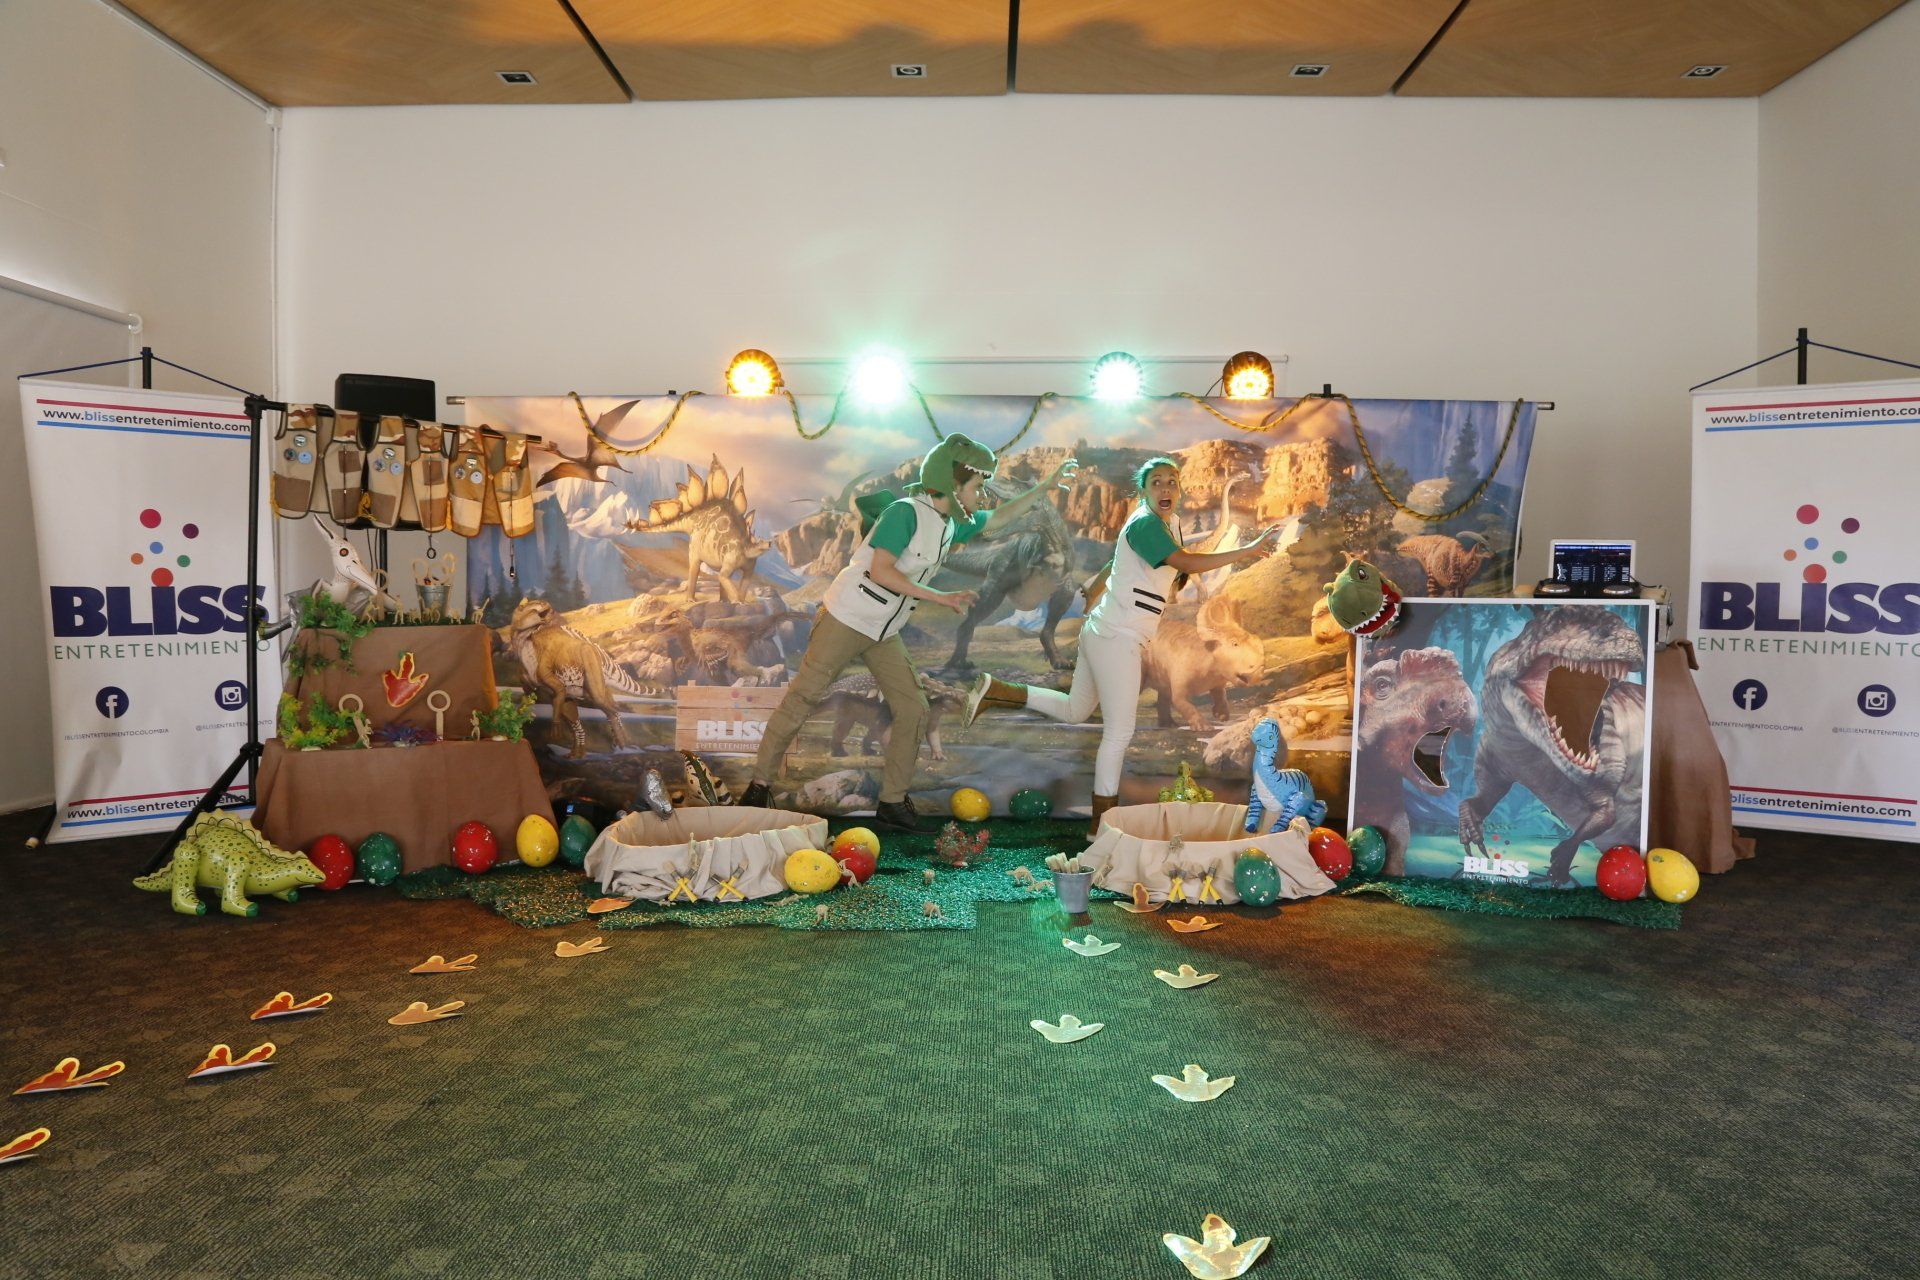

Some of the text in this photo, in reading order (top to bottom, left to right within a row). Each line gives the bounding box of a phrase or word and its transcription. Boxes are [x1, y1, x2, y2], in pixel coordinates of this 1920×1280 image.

[43, 408, 250, 432] www.blissentretenimiento.com
[1711, 407, 1920, 425] www.blissentretenimiento.co
[1730, 793, 1912, 818] blissentretenimiento.com
